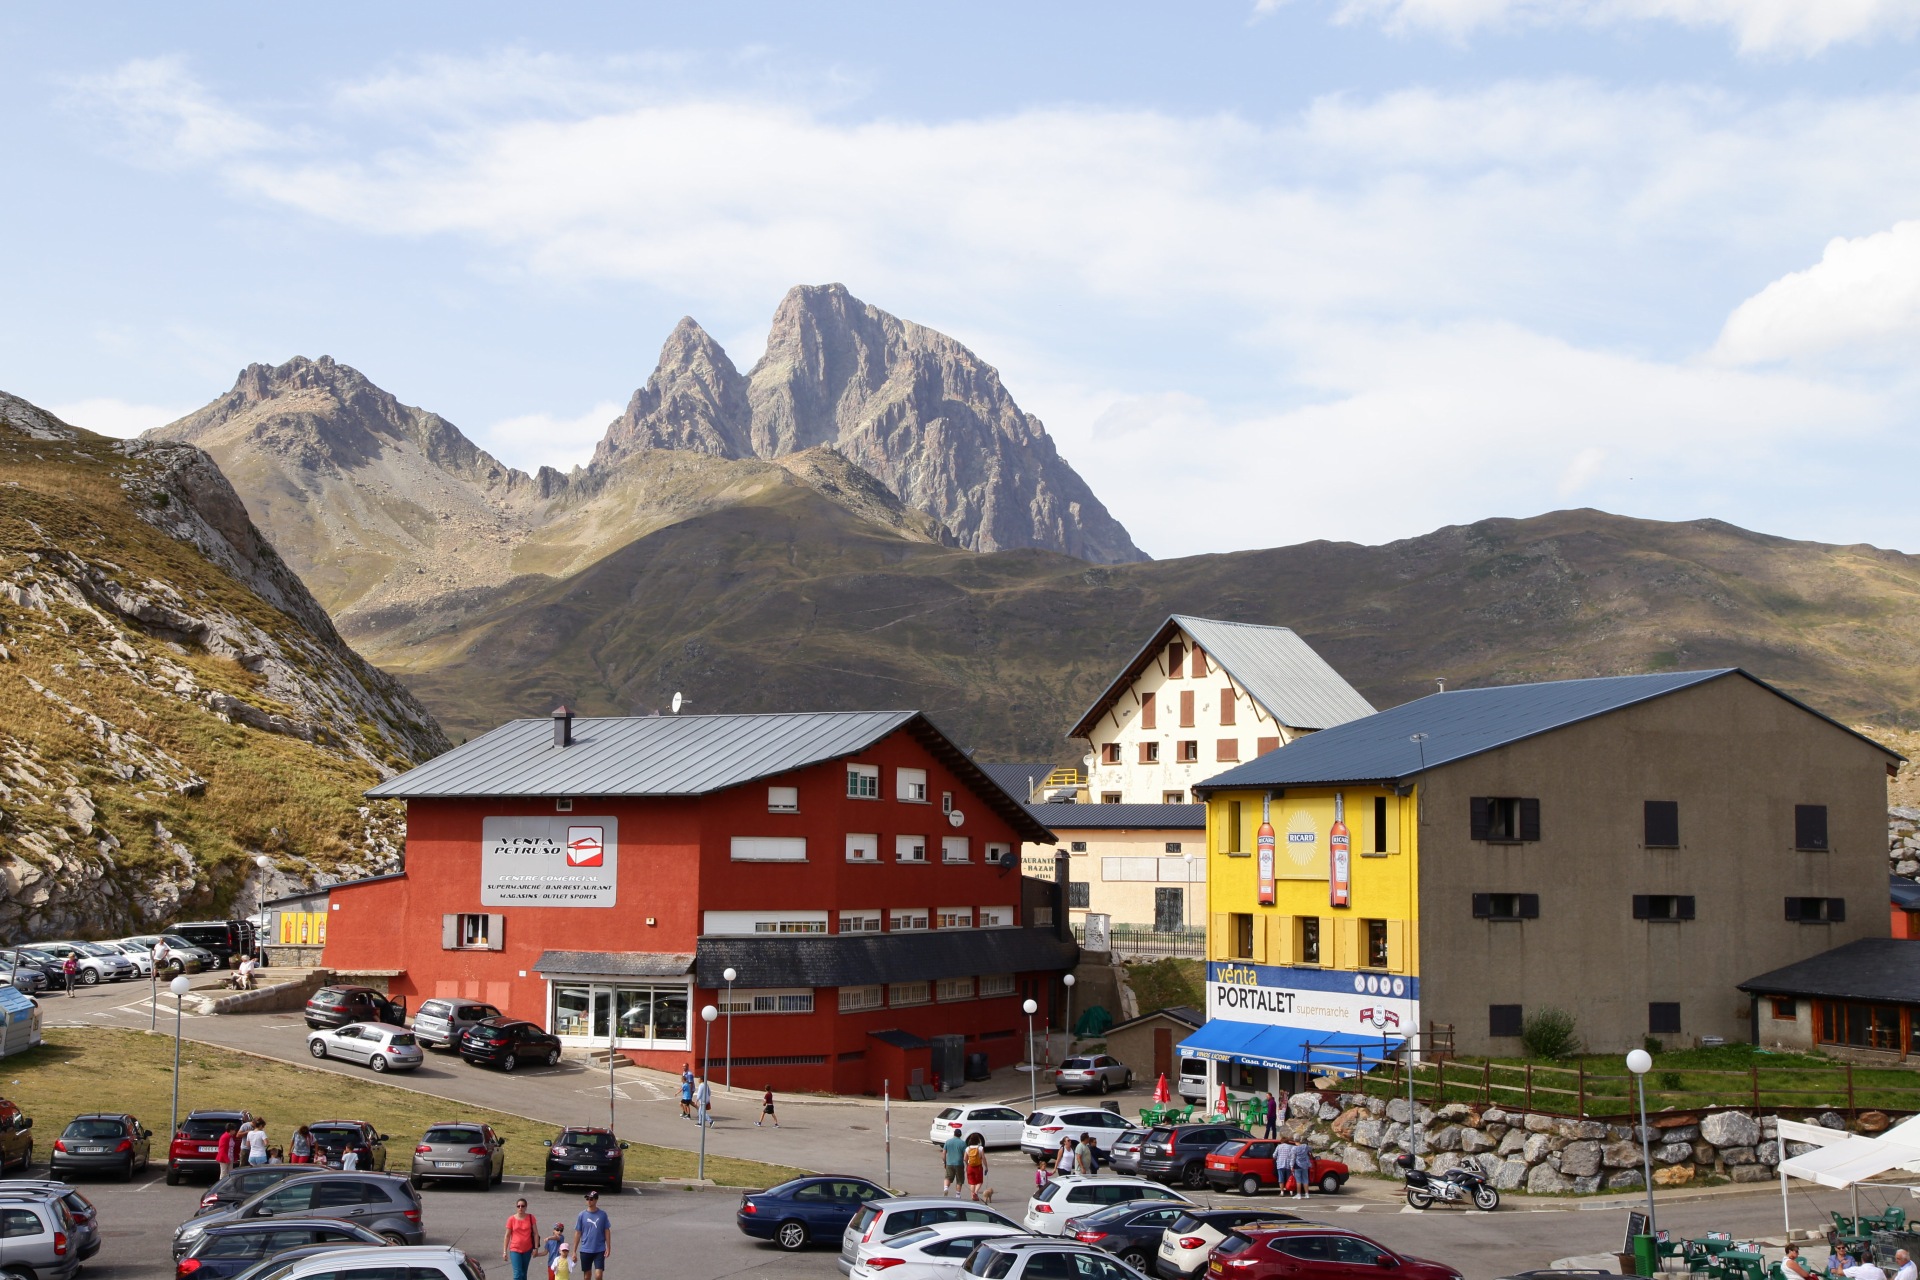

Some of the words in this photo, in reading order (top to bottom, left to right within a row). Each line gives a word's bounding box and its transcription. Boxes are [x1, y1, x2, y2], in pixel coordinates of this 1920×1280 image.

[1289, 834, 1314, 842] RICARD
[1217, 966, 1257, 986] venta
[1218, 986, 1295, 1013] PORTALET
[1241, 1057, 1259, 1065] Casa
[1262, 1060, 1291, 1070] Enrique
